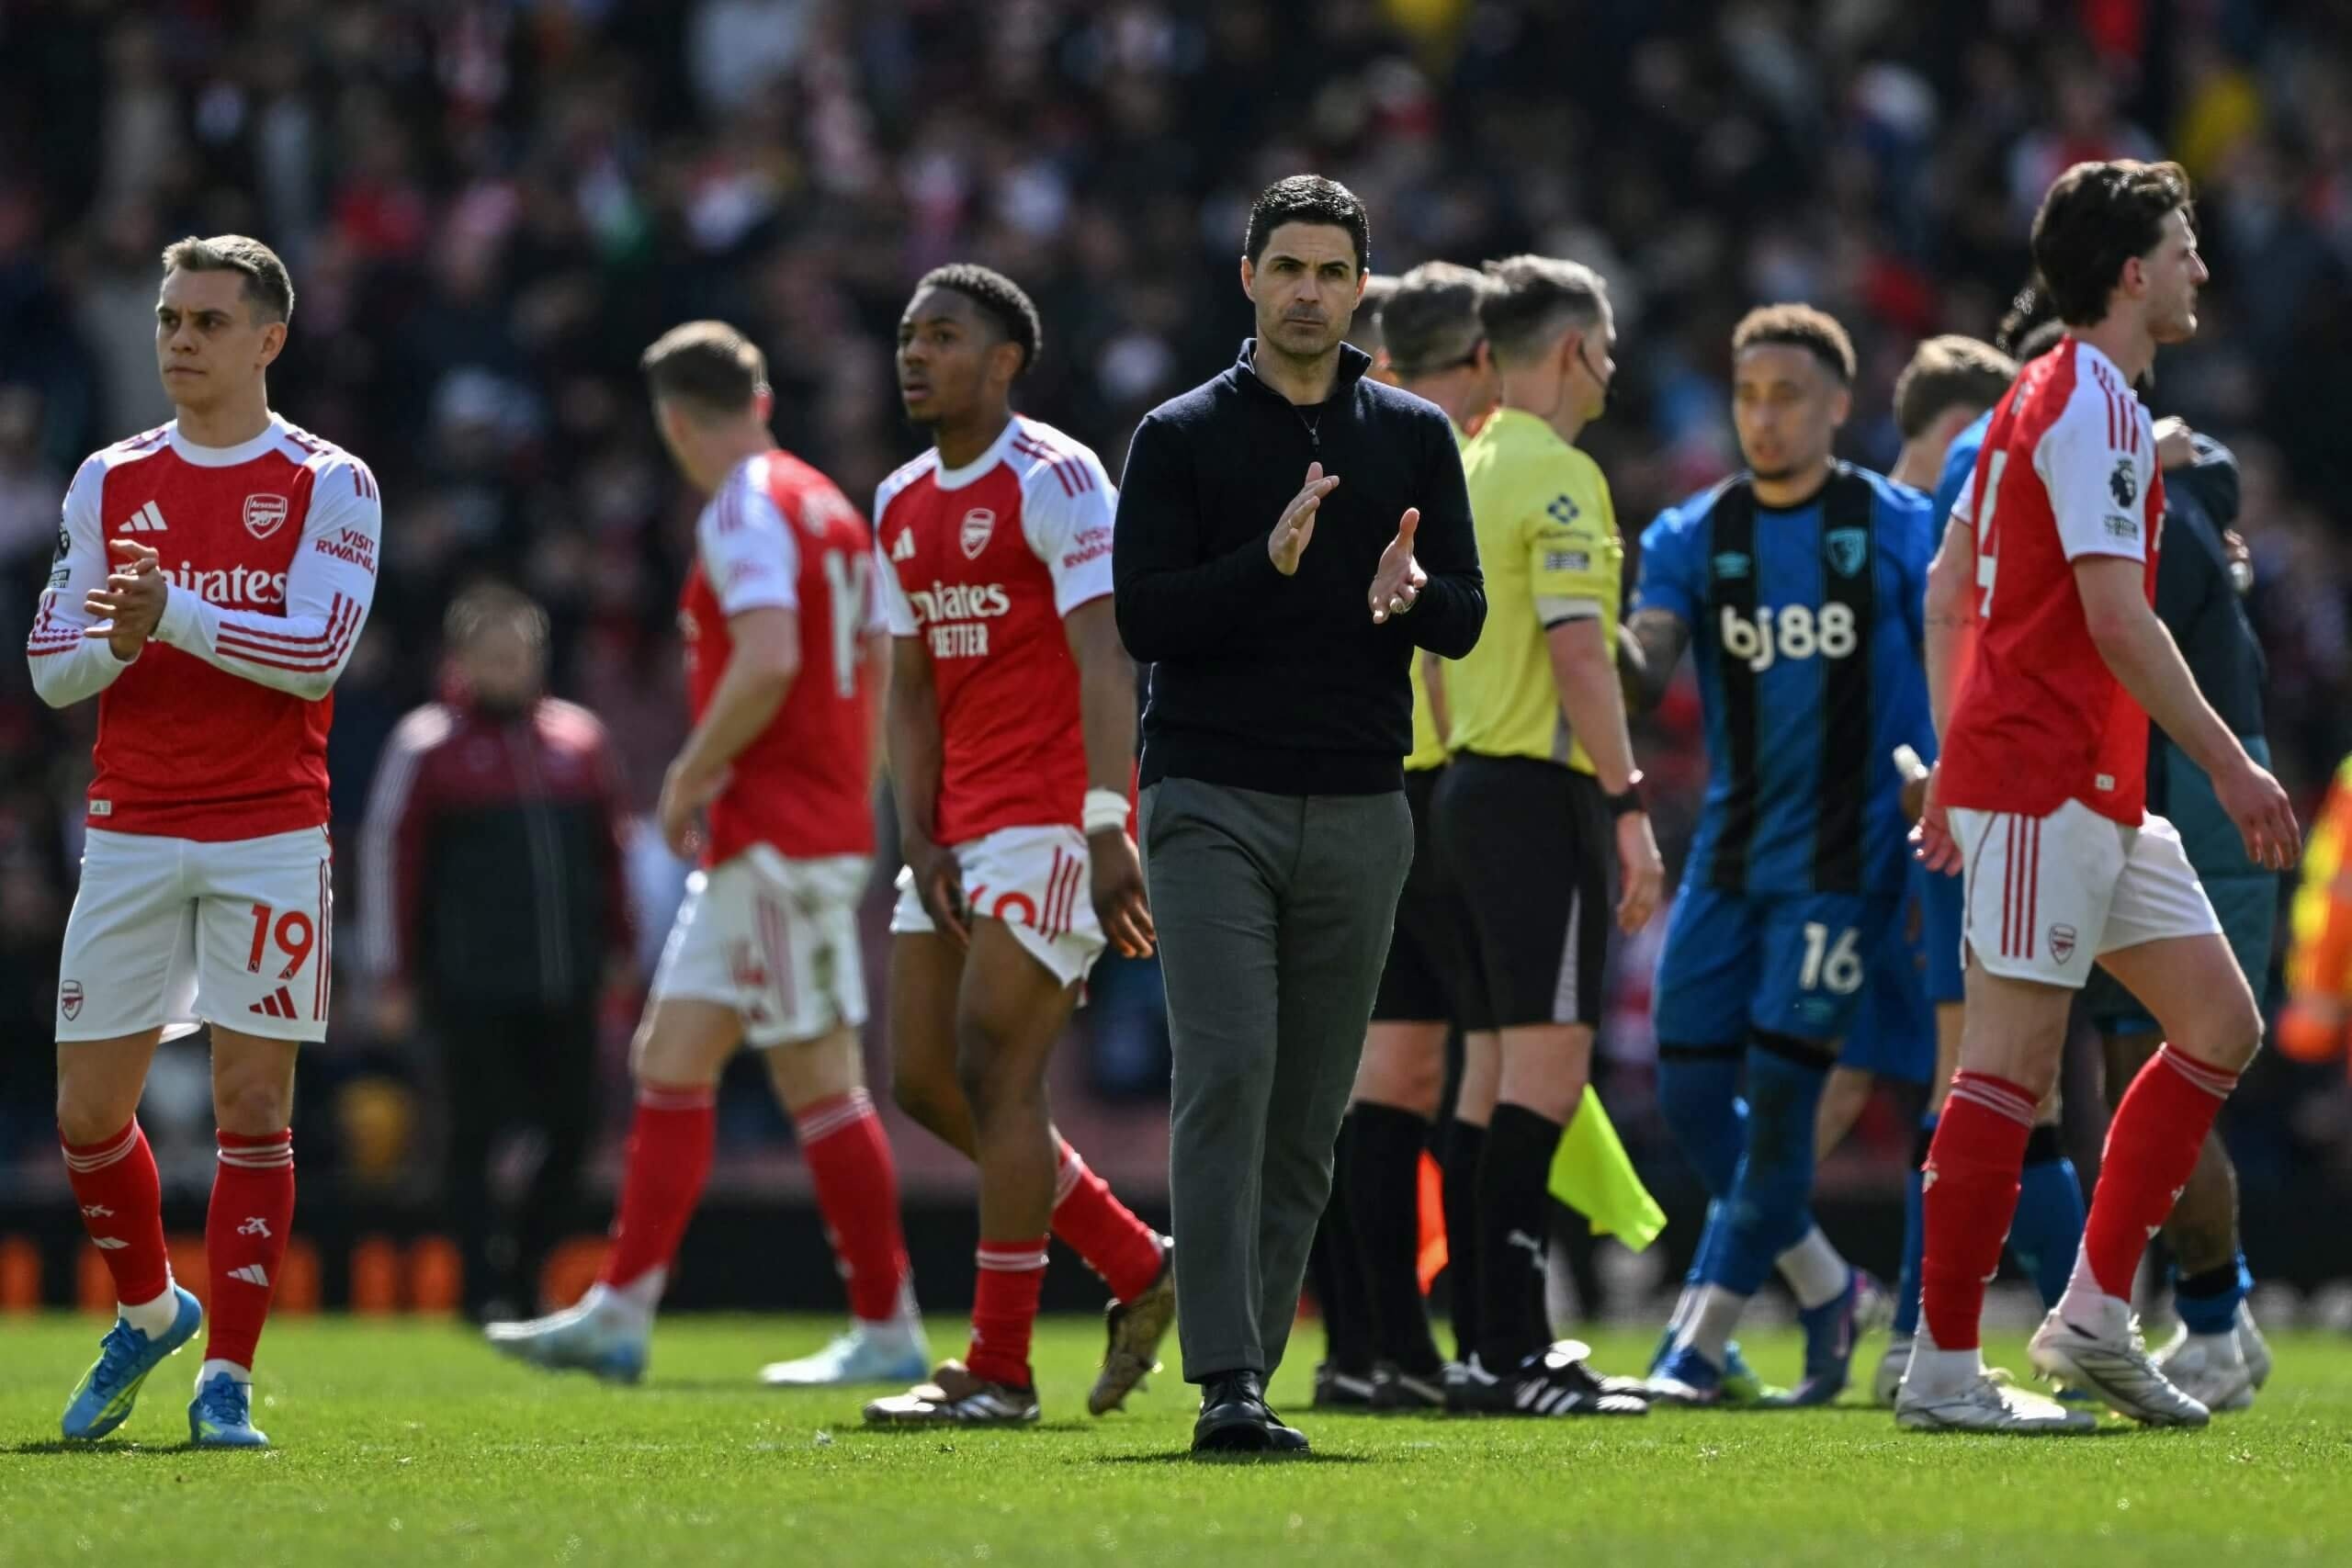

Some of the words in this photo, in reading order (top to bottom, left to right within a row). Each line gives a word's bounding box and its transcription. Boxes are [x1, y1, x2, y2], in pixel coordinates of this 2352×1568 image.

[316, 539, 376, 575] RWAN
[341, 527, 375, 552] VISIT
[115, 560, 287, 604] irates
[1721, 602, 1858, 671] bj88
[247, 903, 314, 980] 19
[1799, 921, 1864, 995] 16
